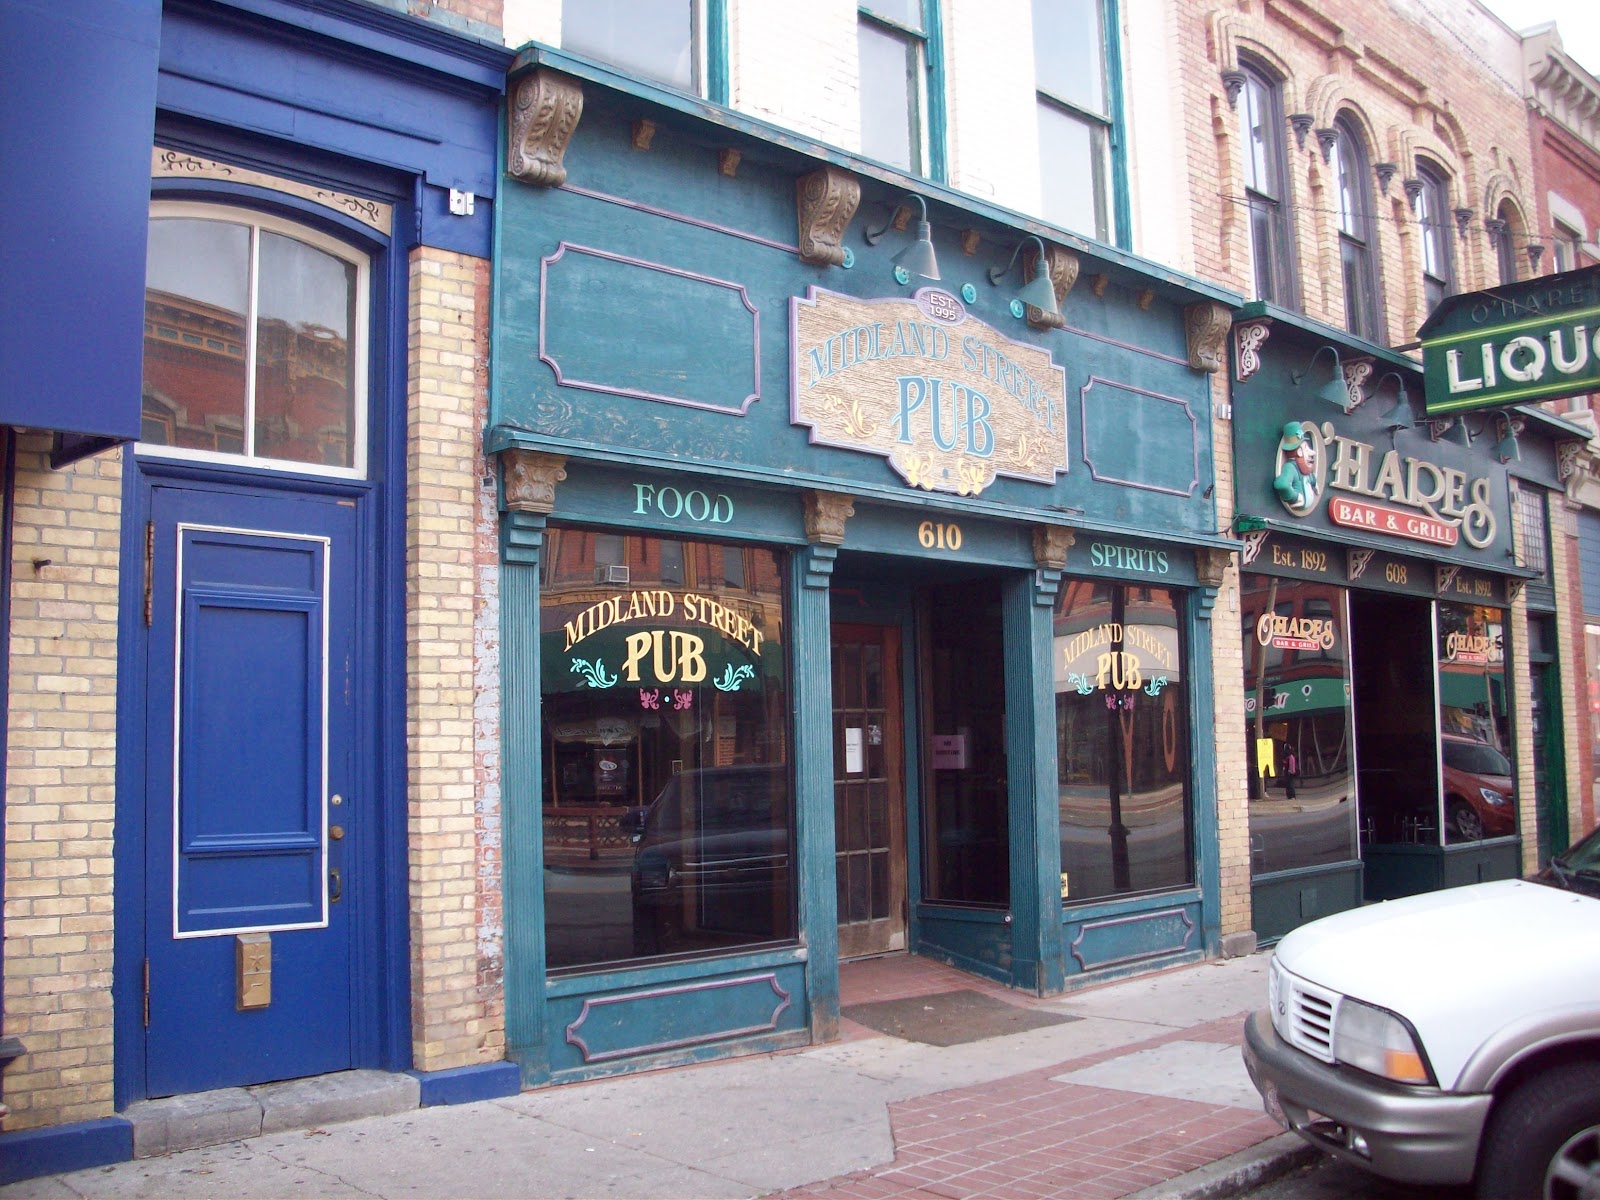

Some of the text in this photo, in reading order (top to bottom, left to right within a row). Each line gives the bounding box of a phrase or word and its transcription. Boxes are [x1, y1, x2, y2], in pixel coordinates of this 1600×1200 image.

[929, 305, 957, 321] 1995
[930, 294, 956, 310] EST.
[808, 321, 1058, 432] MIDLAND STREET
[1446, 325, 1600, 393] LIQU
[892, 376, 996, 459] PUB
[633, 483, 735, 524] FOOD
[1275, 420, 1497, 549] O'HARES
[918, 521, 963, 551] 610
[1339, 504, 1454, 543] BAR & GRILL
[1090, 542, 1170, 575] SPIRITS
[1272, 544, 1327, 572] Est. 1892
[1385, 562, 1407, 586] 608
[1456, 575, 1492, 597] Est. 1892
[563, 590, 766, 657] MIDLAND STREET
[1257, 611, 1334, 649] O'HARES
[621, 630, 708, 683] PUB
[1063, 622, 1173, 671] MIDLAND STREET
[1276, 638, 1289, 647] BAR
[1298, 641, 1317, 649] GRILL
[1095, 650, 1142, 690] PUB
